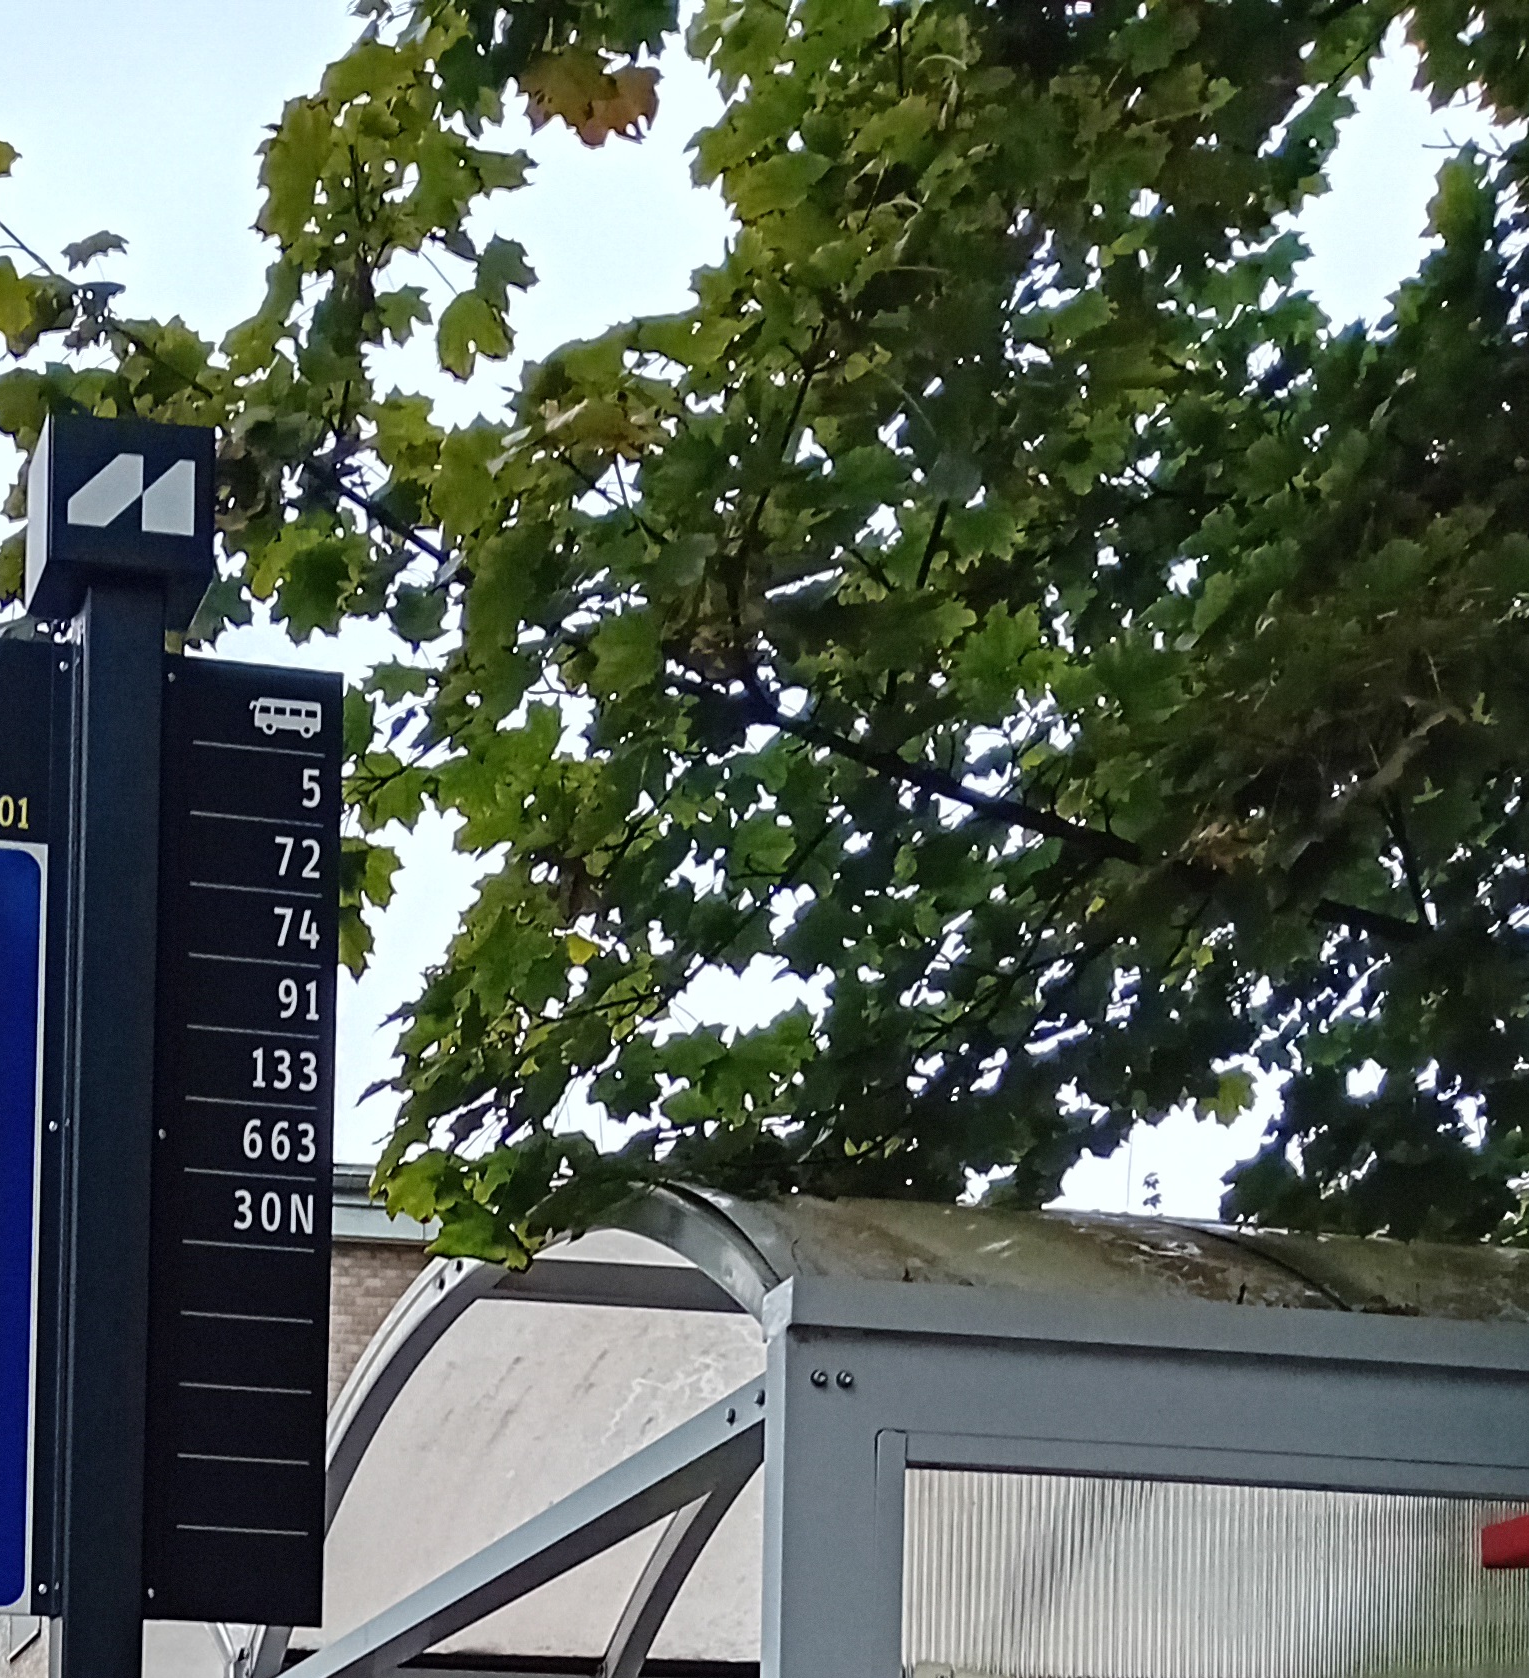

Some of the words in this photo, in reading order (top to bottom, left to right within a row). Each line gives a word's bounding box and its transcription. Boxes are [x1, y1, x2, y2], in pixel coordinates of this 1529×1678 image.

[302, 768, 321, 808] 5
[274, 835, 321, 879] 72
[273, 906, 321, 950] 74
[278, 978, 320, 1021] 91
[252, 1047, 318, 1092] 133
[243, 1118, 316, 1163] 663
[233, 1189, 314, 1235] 30N
